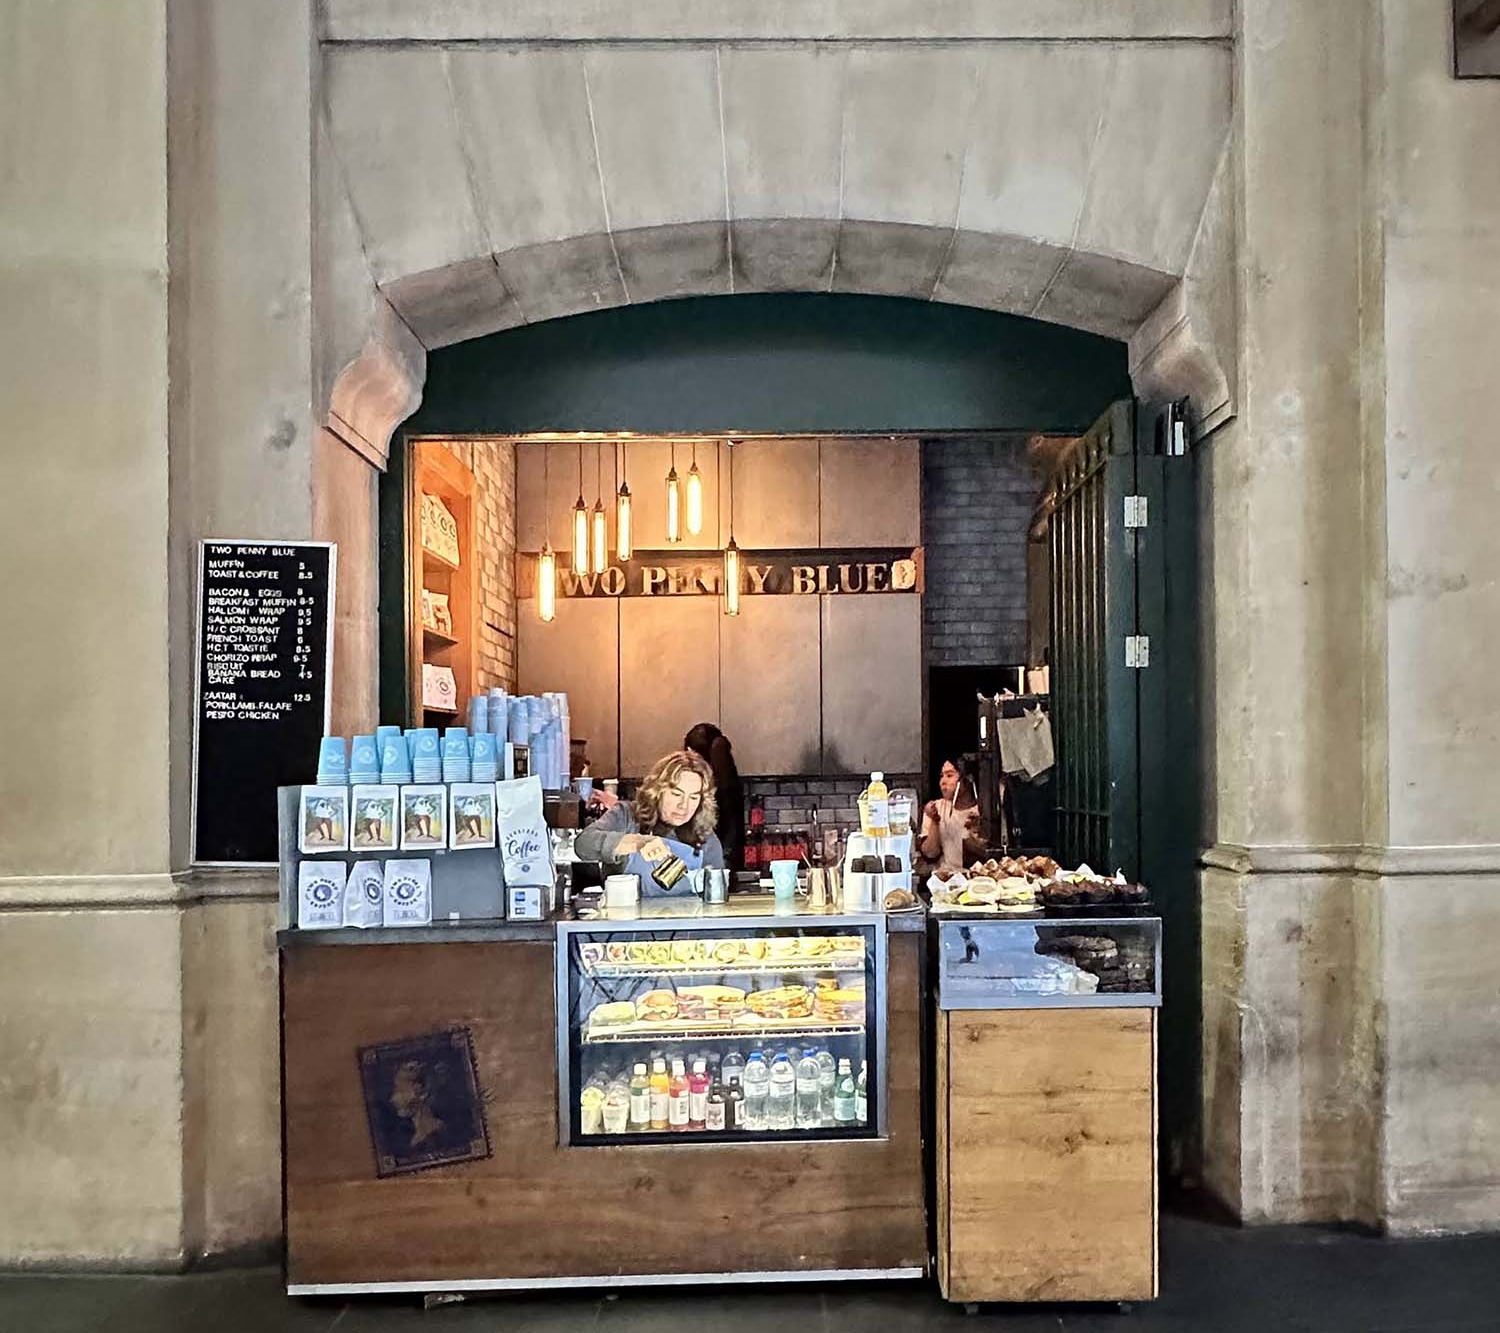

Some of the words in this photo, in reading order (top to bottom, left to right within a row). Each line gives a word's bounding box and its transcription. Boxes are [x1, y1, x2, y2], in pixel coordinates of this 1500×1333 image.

[210, 546, 232, 555] TWO
[237, 547, 267, 556] PENNY
[272, 548, 296, 556] BLUE
[208, 560, 245, 568] MUFFIN
[299, 562, 305, 570] 5
[208, 569, 237, 578] TOAST
[245, 570, 279, 580] COFFEE
[792, 563, 889, 594] BLUE
[208, 588, 242, 597] BACON
[258, 588, 282, 597] EGGS
[208, 597, 259, 607] BREAKFAST
[262, 598, 297, 607] MUFFIN
[258, 607, 286, 616] WRAP
[207, 615, 246, 624] SALMON
[249, 616, 279, 625] WRAP
[229, 625, 280, 635] CROISSANT
[206, 633, 242, 643] FRENCH
[245, 634, 278, 643] TOAST
[233, 643, 268, 653] TOASTIE
[206, 653, 250, 663] CHORIZO
[251, 653, 278, 662] WRAP
[207, 669, 247, 678] BANANA
[250, 670, 281, 678] BREAD
[208, 676, 235, 684] CAKE
[206, 711, 235, 719] PESTO
[238, 711, 279, 720] CHICKEN
[505, 840, 540, 859] Coffee
